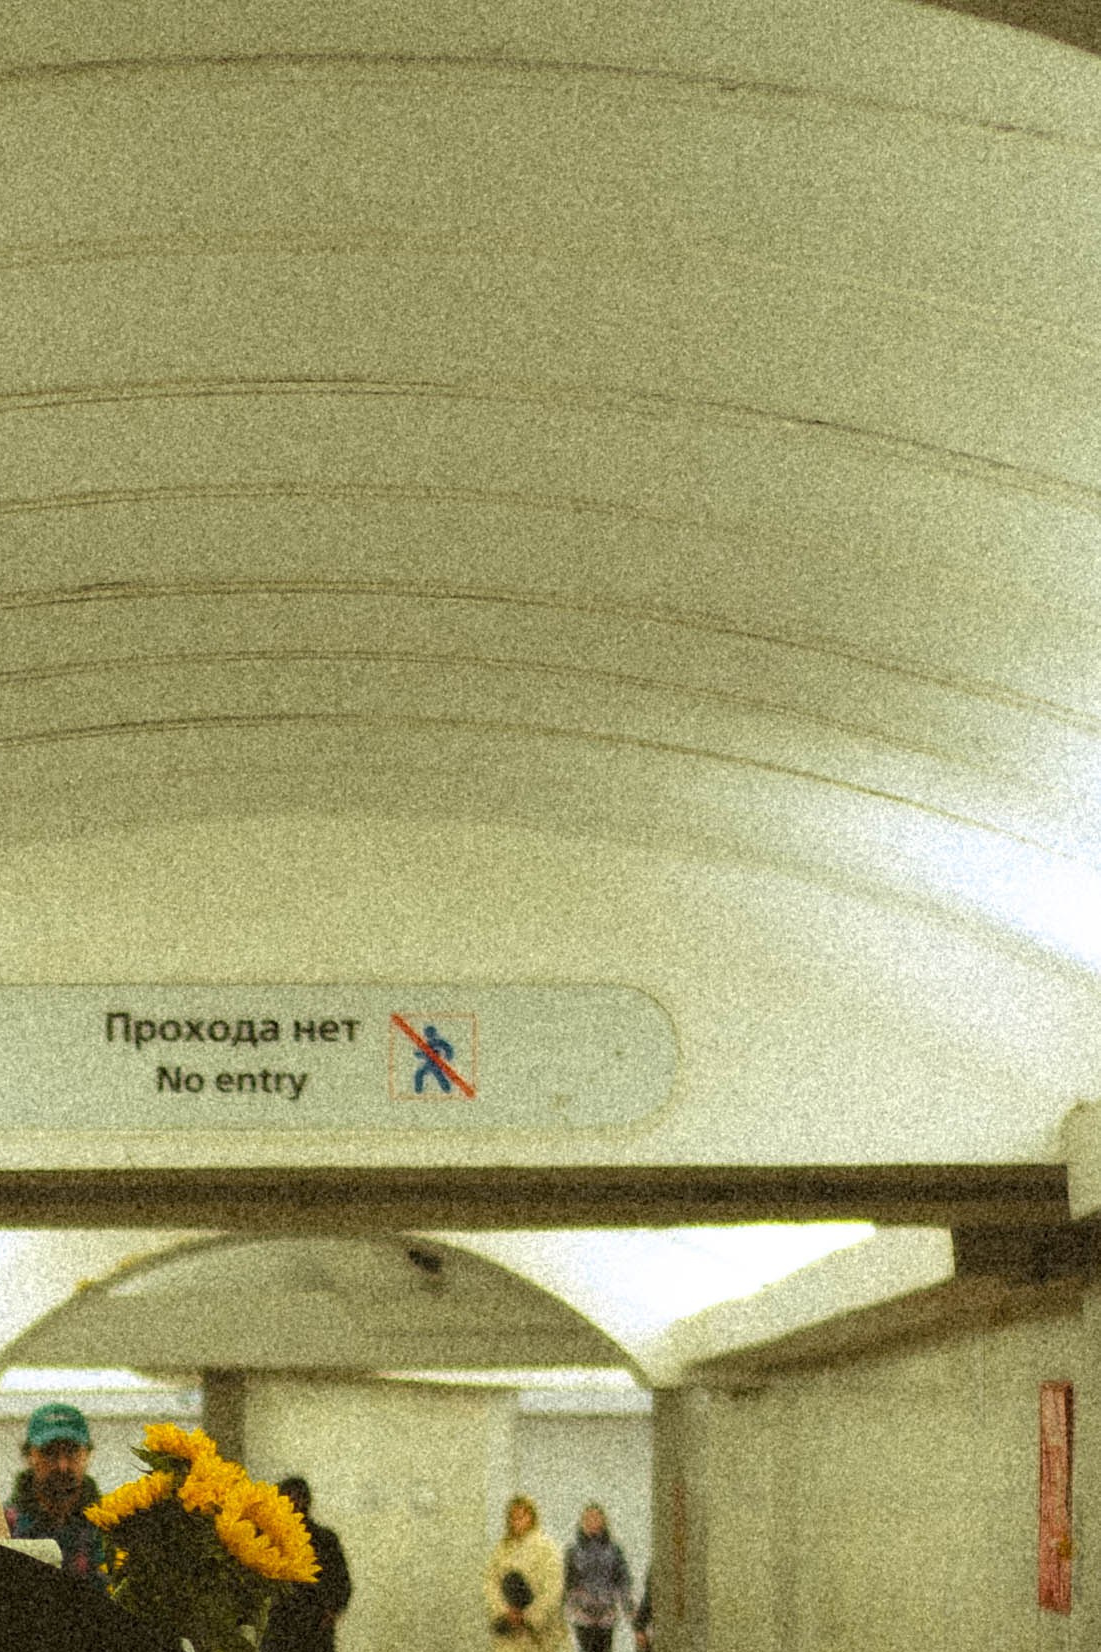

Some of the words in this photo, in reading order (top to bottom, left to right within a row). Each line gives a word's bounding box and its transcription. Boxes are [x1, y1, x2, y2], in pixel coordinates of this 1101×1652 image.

[105, 1013, 280, 1048] Прохода
[294, 1019, 362, 1042] нет
[156, 1066, 205, 1093] No
[215, 1069, 308, 1100] entry
